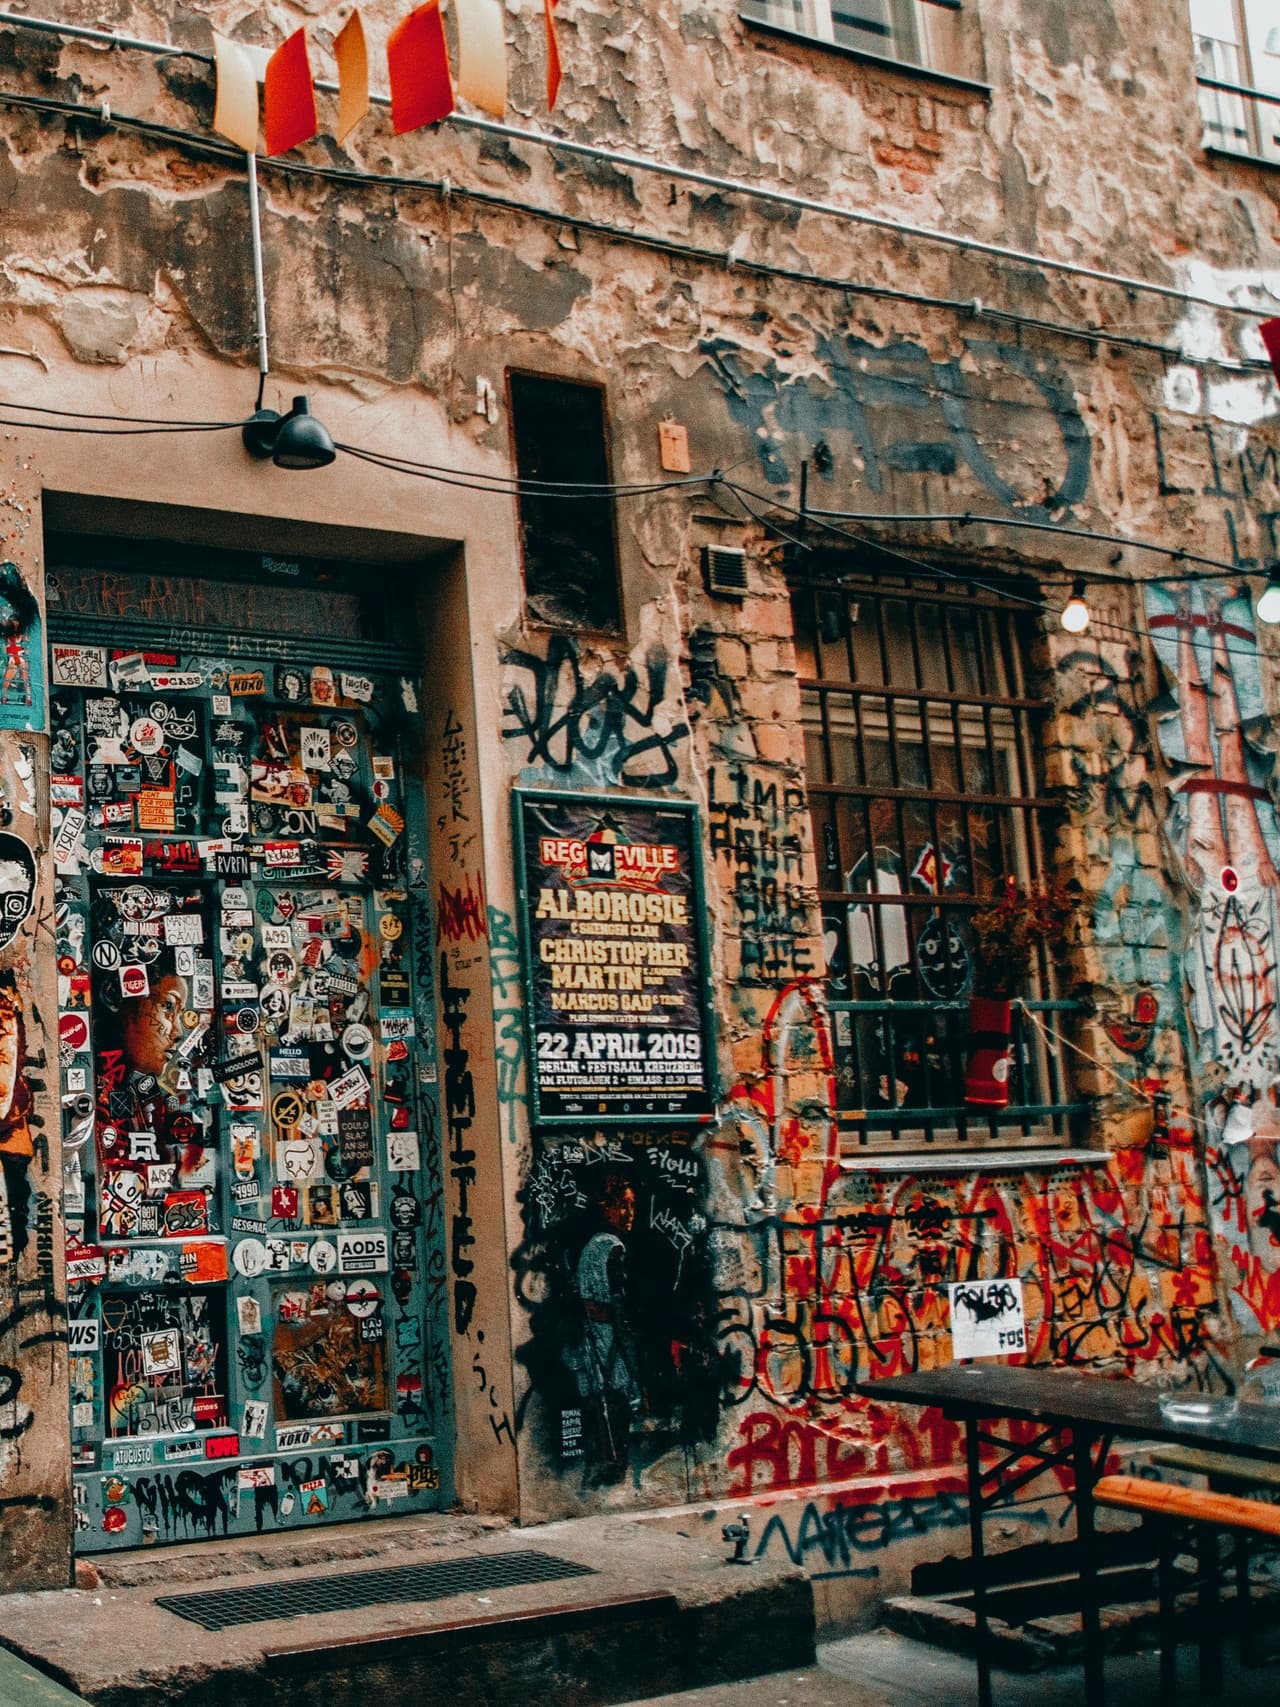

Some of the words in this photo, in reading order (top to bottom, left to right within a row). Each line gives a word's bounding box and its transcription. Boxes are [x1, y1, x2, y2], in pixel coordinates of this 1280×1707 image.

[233, 679, 264, 692] KOKO
[535, 888, 689, 925] ALBOROSIE
[630, 924, 660, 937] CLAN
[539, 938, 689, 967] CHRISTOPHER
[551, 964, 643, 990] MARTIN
[551, 993, 620, 1011] MARCUS
[279, 1048, 302, 1056] HELLO
[537, 1033, 568, 1059] 22
[572, 1033, 646, 1059] APRIL
[648, 1033, 701, 1059] 2019
[538, 1062, 579, 1072] BERLIN
[587, 1062, 642, 1073] FESTSAAL
[644, 1062, 702, 1073] KREUZBERG
[540, 1076, 554, 1085] AM
[341, 1122, 369, 1130] COULD
[345, 1132, 366, 1140] SLAP
[237, 1183, 258, 1199] 1990
[74, 1248, 91, 1256] Hello
[341, 1240, 385, 1255] AODS
[278, 1432, 310, 1447] KOKO
[302, 1480, 324, 1491] PIZZA
